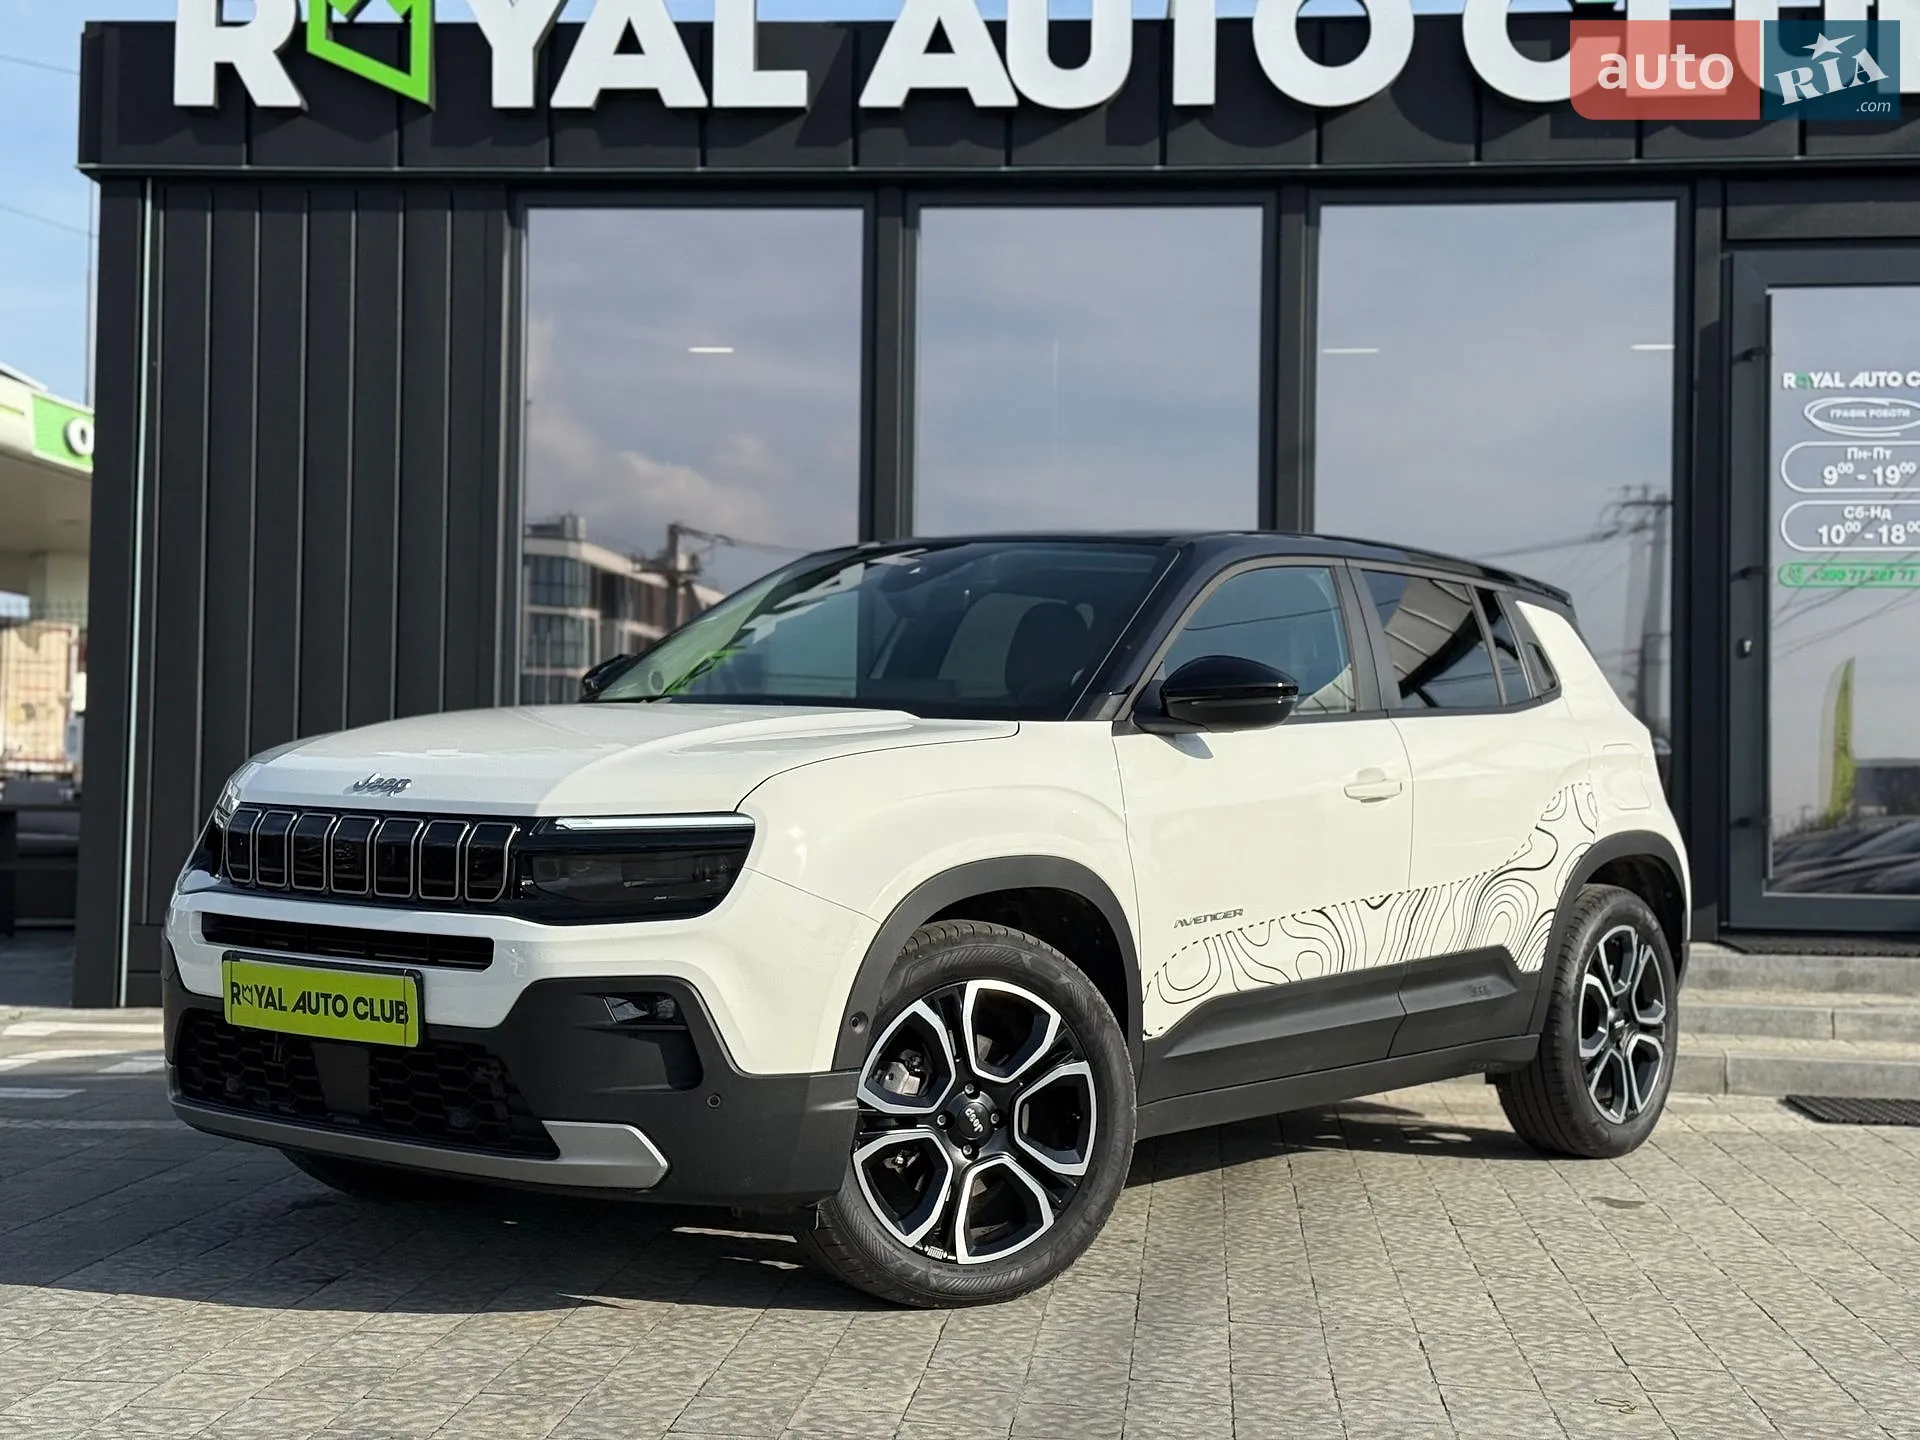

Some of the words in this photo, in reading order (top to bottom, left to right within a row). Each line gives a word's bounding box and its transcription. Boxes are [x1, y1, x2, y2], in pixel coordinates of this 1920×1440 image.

[1849, 371, 1903, 388] AUTO
[1847, 447, 1892, 460] Пн-Пт
[1843, 505, 1892, 521] Сб-Нд
[353, 772, 412, 797] Jeep
[1173, 908, 1244, 928] AVENGER
[291, 990, 349, 1019] AUTO
[352, 996, 409, 1026] CLUB
[964, 1107, 984, 1133] Jeep
